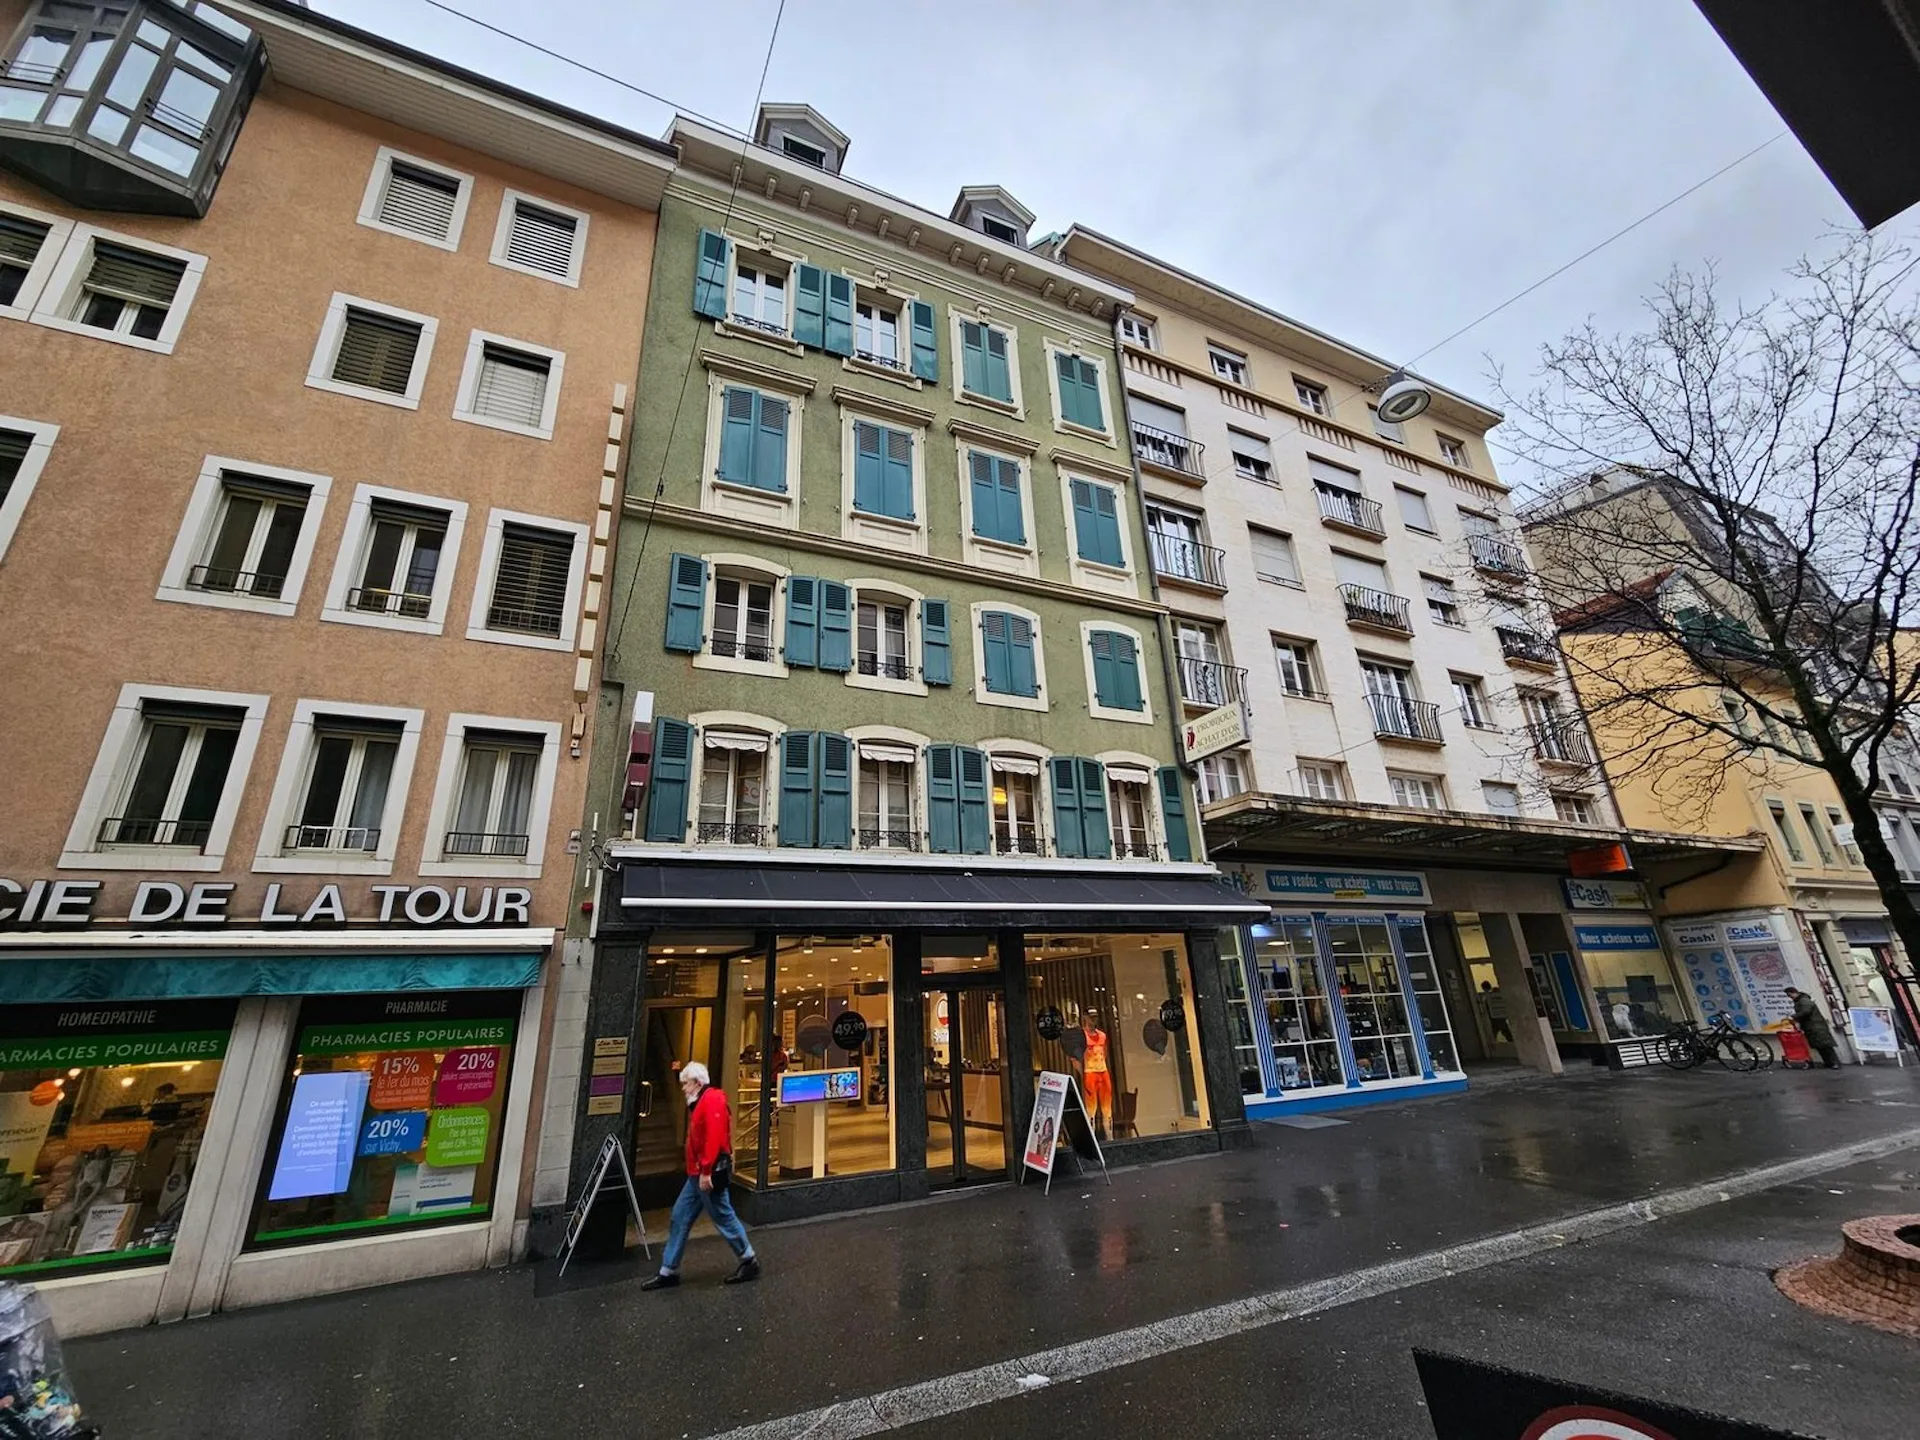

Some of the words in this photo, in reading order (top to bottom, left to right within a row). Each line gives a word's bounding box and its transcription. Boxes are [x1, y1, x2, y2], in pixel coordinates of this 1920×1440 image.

[1270, 874, 1290, 887] vous
[1325, 877, 1343, 889] vous
[1376, 879, 1394, 891] vous
[1576, 883, 1611, 902] Cash
[128, 881, 236, 922] DE
[260, 883, 346, 922] LA
[371, 884, 531, 924] TOUR
[1580, 932, 1600, 944] Nous
[1602, 932, 1632, 944] achetons
[1680, 933, 1716, 944] Cash!
[1732, 924, 1761, 936] Cash
[385, 1000, 448, 1014] PHARMACIE
[57, 1009, 157, 1027] HOMEOPATHIE
[311, 1030, 411, 1047] PHARMACIES
[417, 1027, 505, 1042] POPULAIRES
[835, 1021, 865, 1036] 49.90
[104, 1039, 220, 1058] POPULAIRES
[382, 1056, 420, 1075] 15%
[457, 1052, 495, 1070] 20%
[400, 1074, 410, 1087] du
[411, 1075, 430, 1086] mois
[367, 1118, 409, 1139] 20%
[364, 1143, 380, 1154] sur
